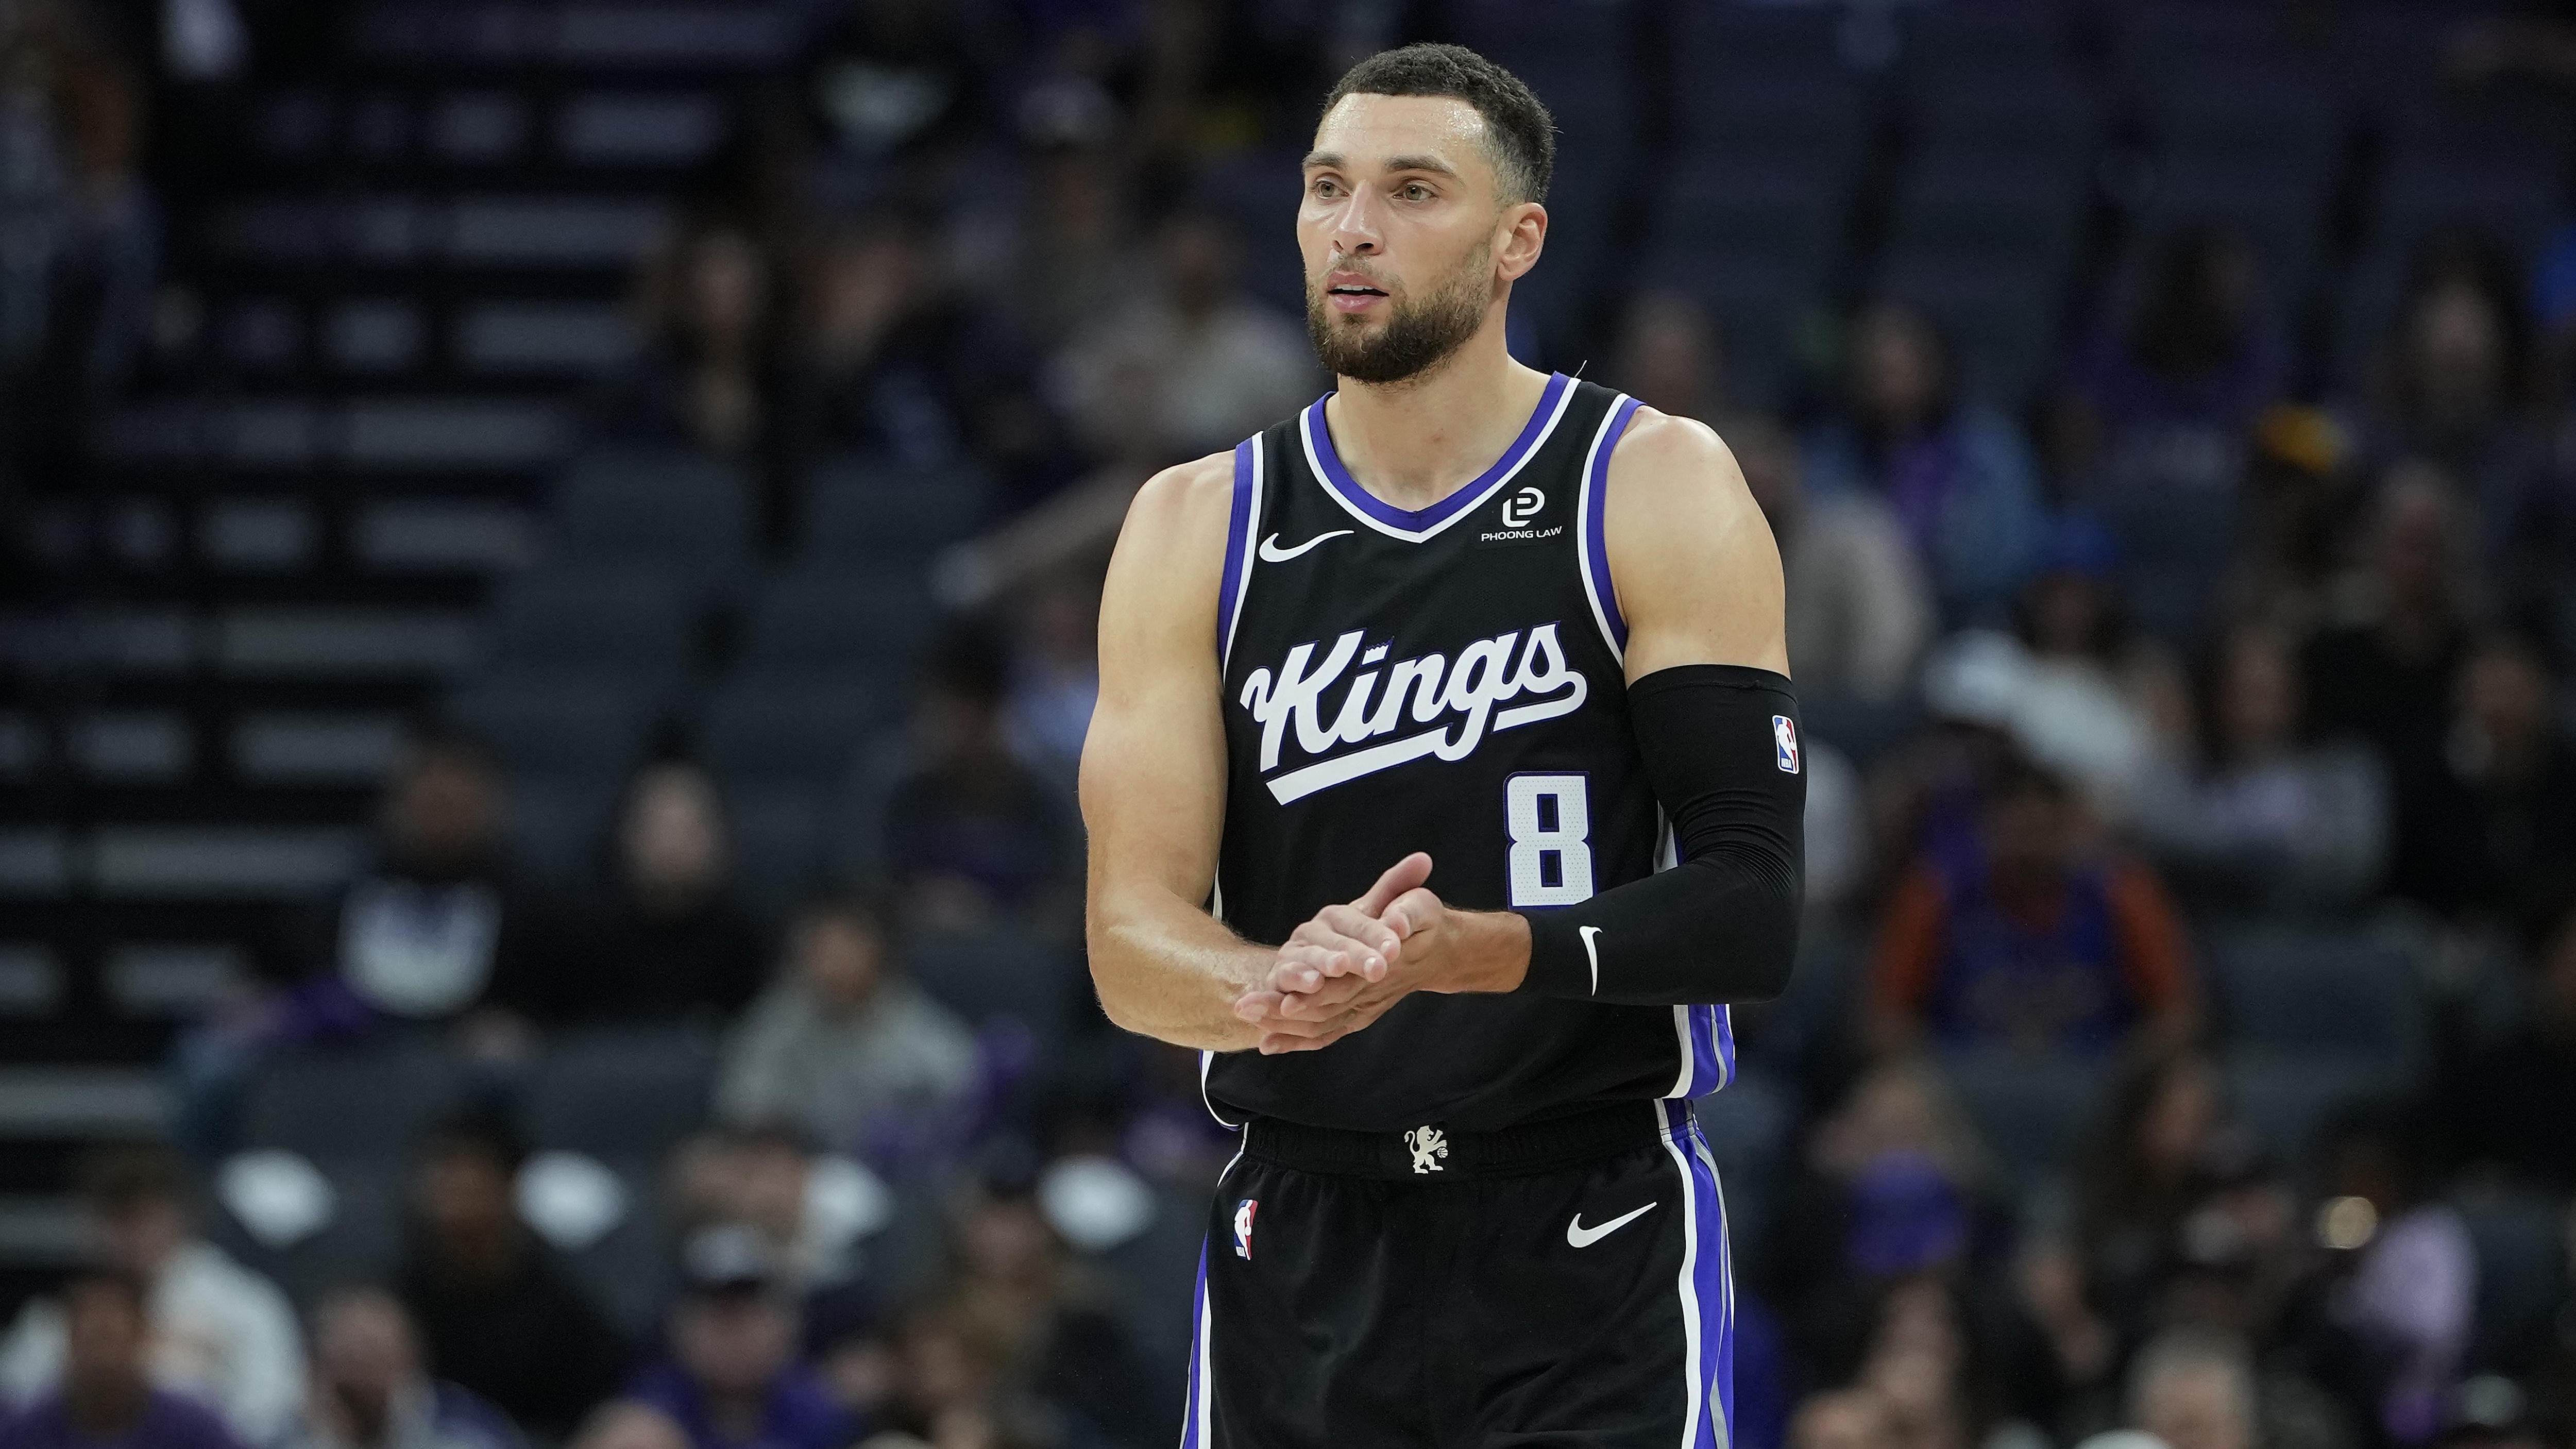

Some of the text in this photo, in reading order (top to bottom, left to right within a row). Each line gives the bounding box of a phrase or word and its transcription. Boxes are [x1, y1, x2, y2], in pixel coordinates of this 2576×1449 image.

[1481, 526, 1563, 542] PHOONG LAW
[1240, 622, 1588, 805] Kings
[1505, 773, 1595, 908] 8
